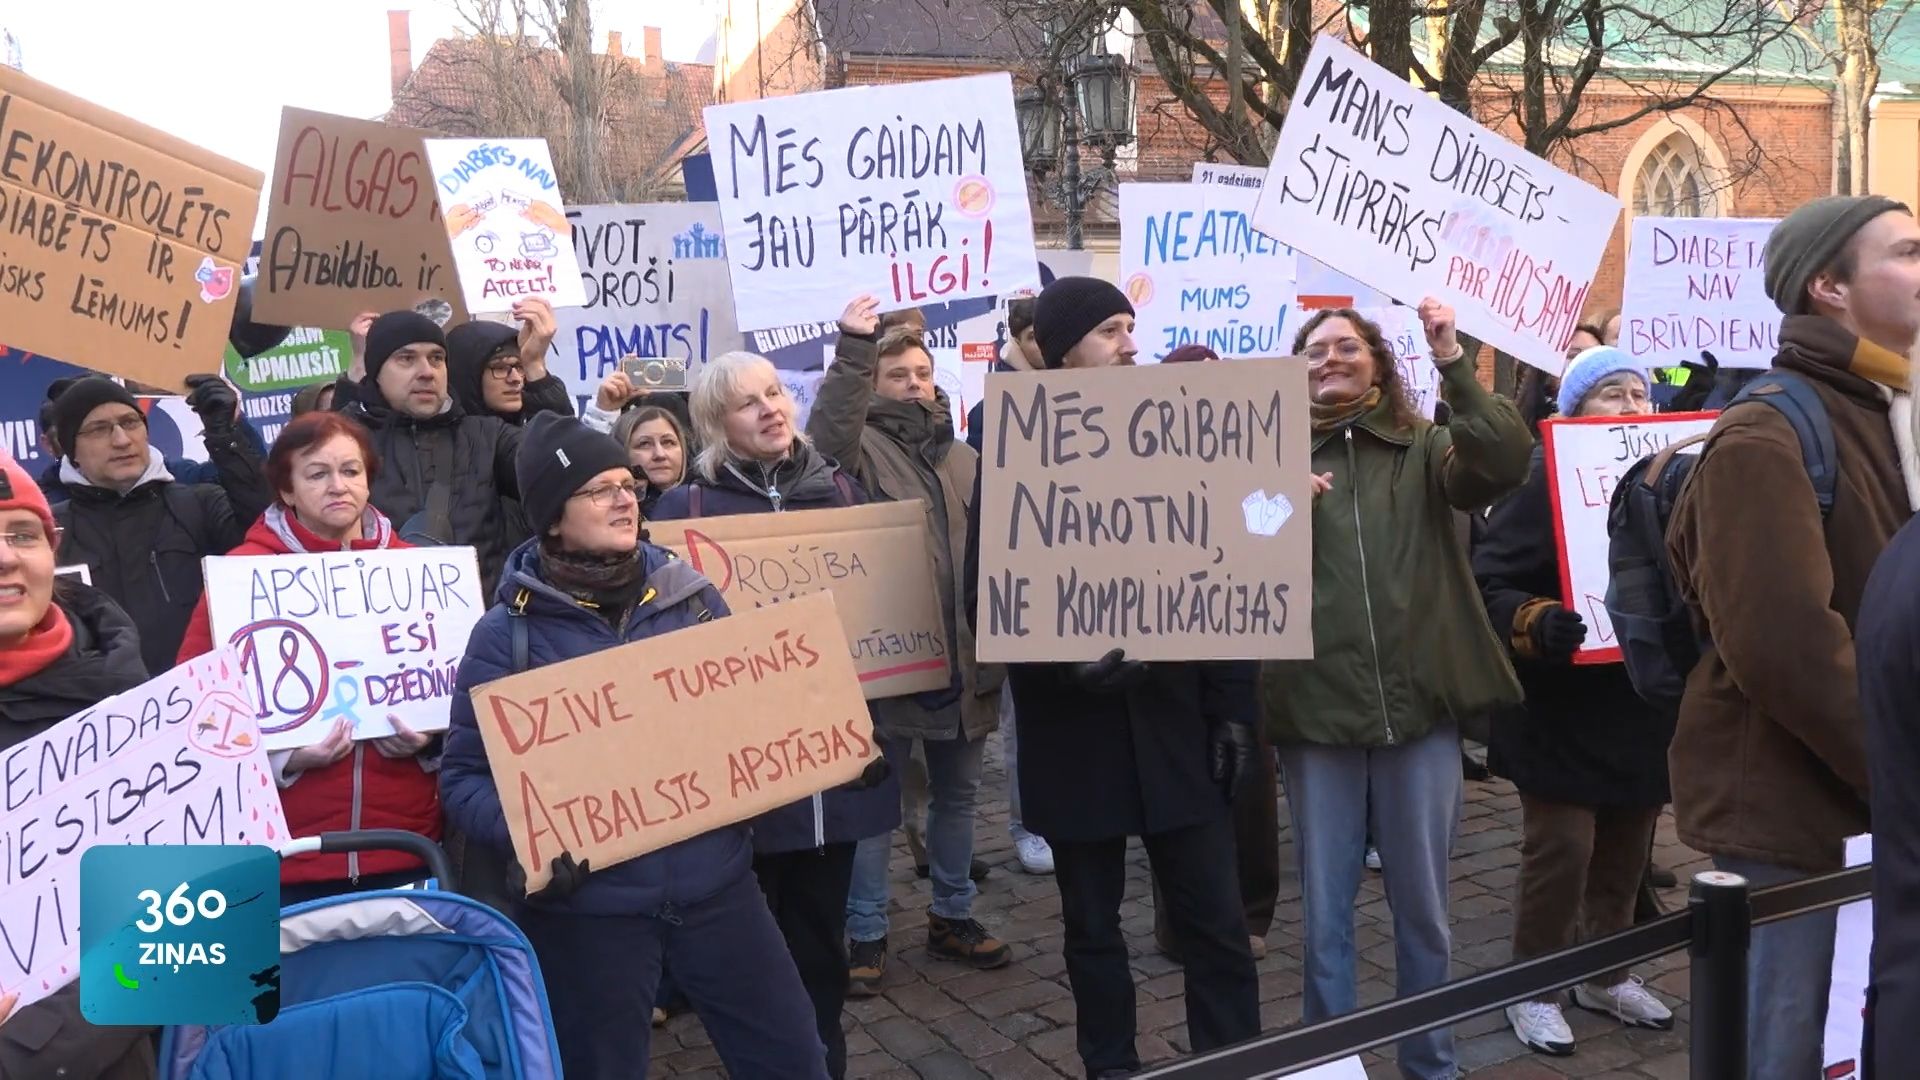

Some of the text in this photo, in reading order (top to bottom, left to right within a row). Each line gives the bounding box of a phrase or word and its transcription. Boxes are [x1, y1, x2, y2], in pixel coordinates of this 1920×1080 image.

[284, 127, 419, 219] ALGAS
[439, 143, 555, 195] DIABĒTS NAV
[730, 114, 986, 199] MĒS GAIDAM
[1304, 56, 1412, 157] MANS
[1430, 125, 1554, 224] DIABĒTS
[741, 189, 947, 271] JAU PĀRĀK
[1280, 134, 1446, 271] STIPRĀKS
[147, 231, 174, 283] IR
[484, 258, 506, 272] TO
[566, 211, 646, 268] ĪVOT
[890, 219, 992, 302] ILGI!
[0, 251, 192, 349] ISKS LĒMUMS!
[483, 265, 557, 298] ATCELT!
[1181, 284, 1250, 311] MUMS
[1446, 256, 1490, 299] PAR
[1688, 272, 1740, 301] NAV
[576, 308, 709, 380] PAMATS!
[1153, 304, 1287, 361] JAUNĪBU!
[245, 393, 292, 418] IKOZES
[997, 383, 1282, 468] MĒS GRIBAM
[1008, 480, 1224, 564] NĀKOTNI,
[684, 529, 867, 594] DROŠĪBA
[381, 612, 436, 654] ESI
[988, 566, 1290, 639] NE KOMPLIKĀCIJAS
[850, 628, 945, 659] UTĀJUMS
[364, 656, 457, 706] DZIEDINĀ
[489, 629, 820, 756] DZĪVE TURPINĀS
[6, 685, 193, 811] ENĀDAS
[0, 747, 202, 885] IESĪBAS
[519, 719, 870, 872] ATBALSTS APSTĀJAS
